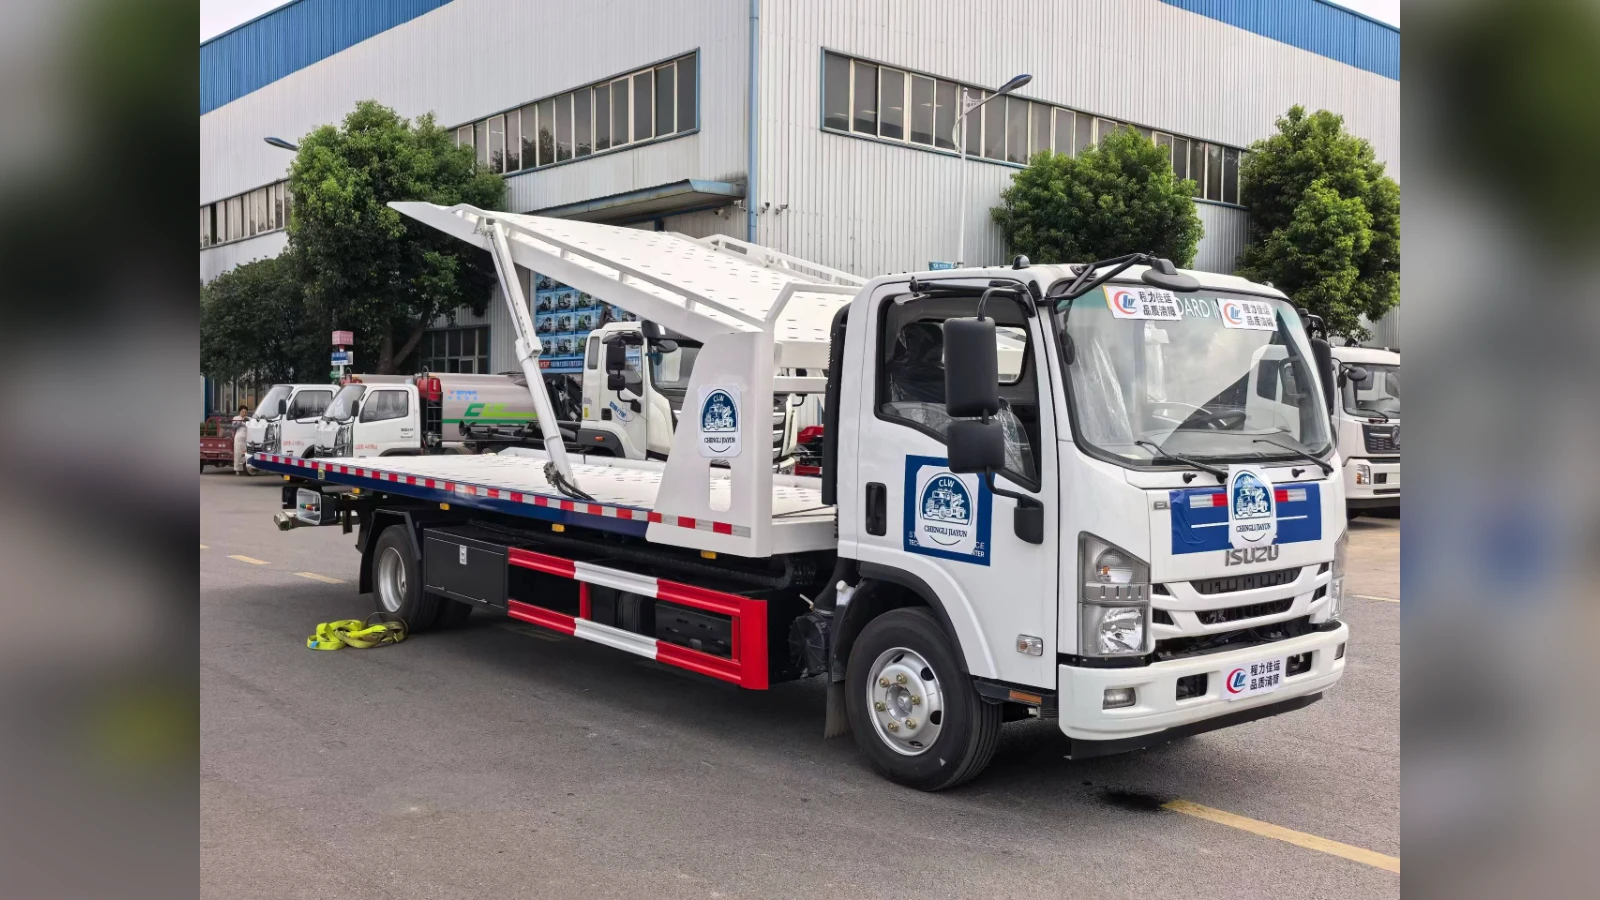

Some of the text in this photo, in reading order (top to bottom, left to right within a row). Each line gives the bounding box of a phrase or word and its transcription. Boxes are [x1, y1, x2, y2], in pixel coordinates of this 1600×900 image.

[938, 479, 954, 488] CLW
[924, 525, 968, 537] CHENGLI JIAYUN
[1224, 545, 1280, 567] ISUZU
[1250, 660, 1280, 677] 程力佳运
